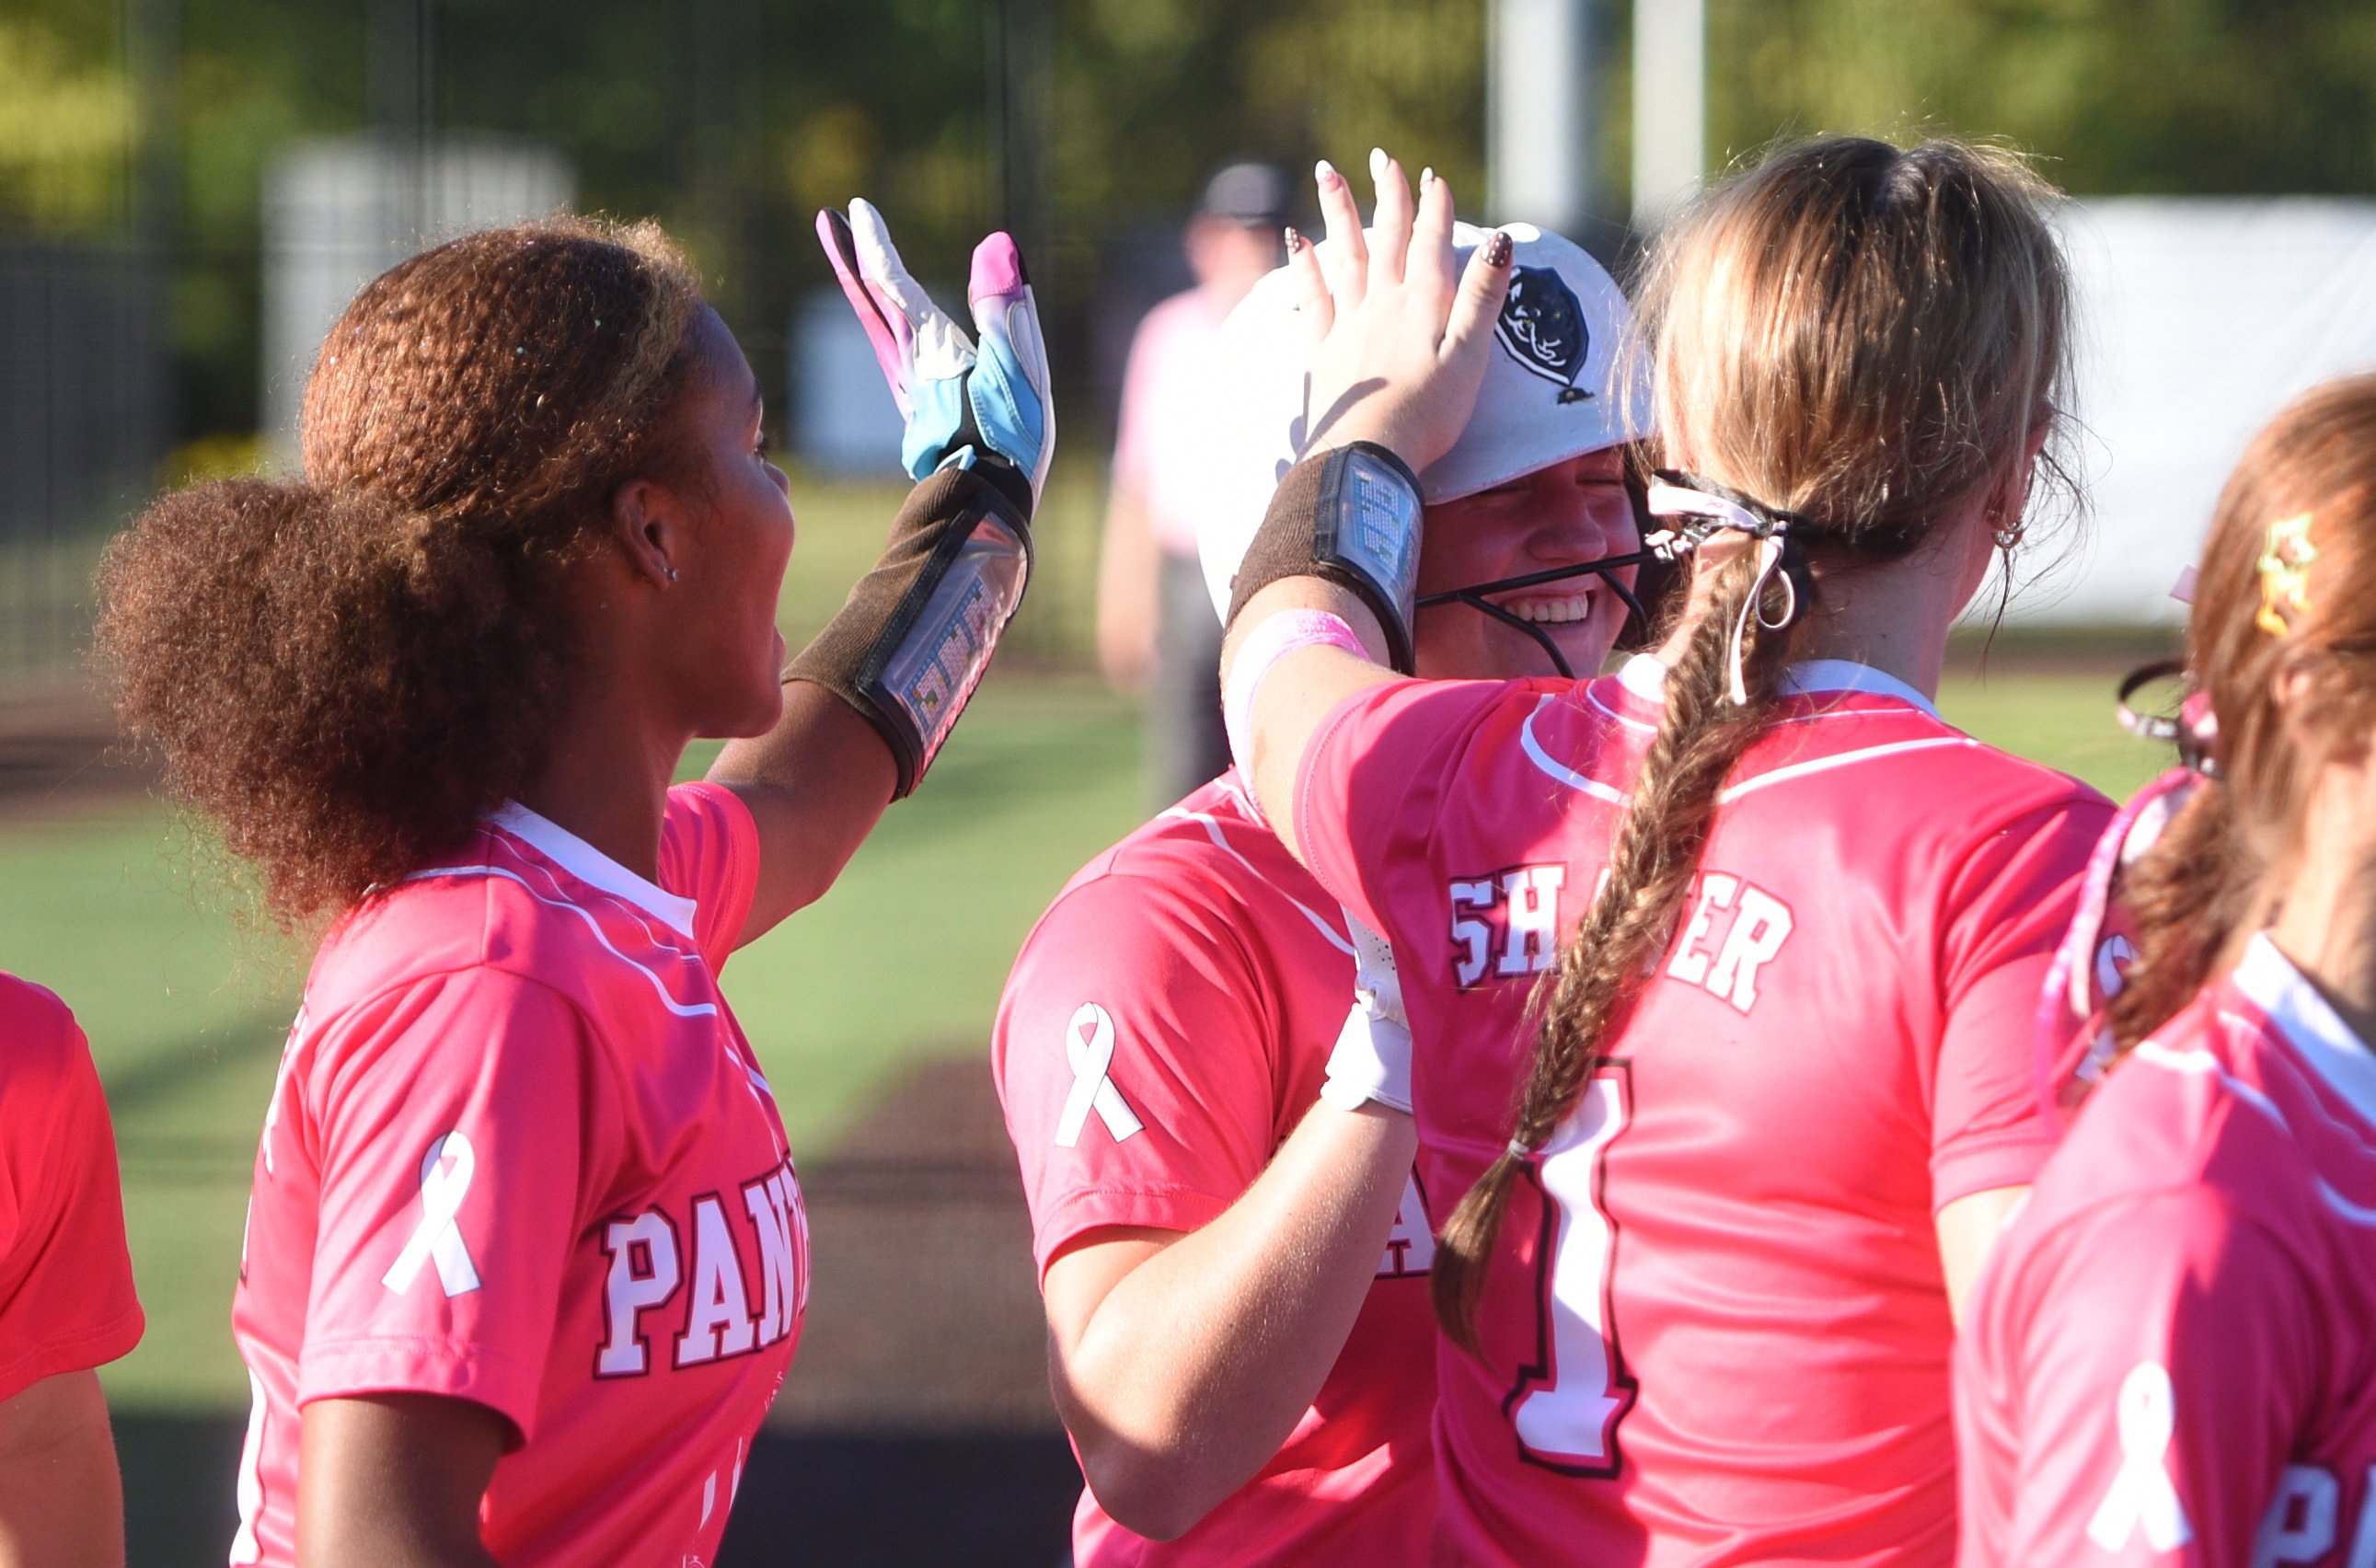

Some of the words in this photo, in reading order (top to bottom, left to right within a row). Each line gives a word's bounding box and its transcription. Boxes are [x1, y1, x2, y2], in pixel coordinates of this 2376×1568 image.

[1449, 863, 1795, 1015] SHER
[1509, 1062, 1631, 1470] 1
[2253, 1463, 2376, 1568] P
